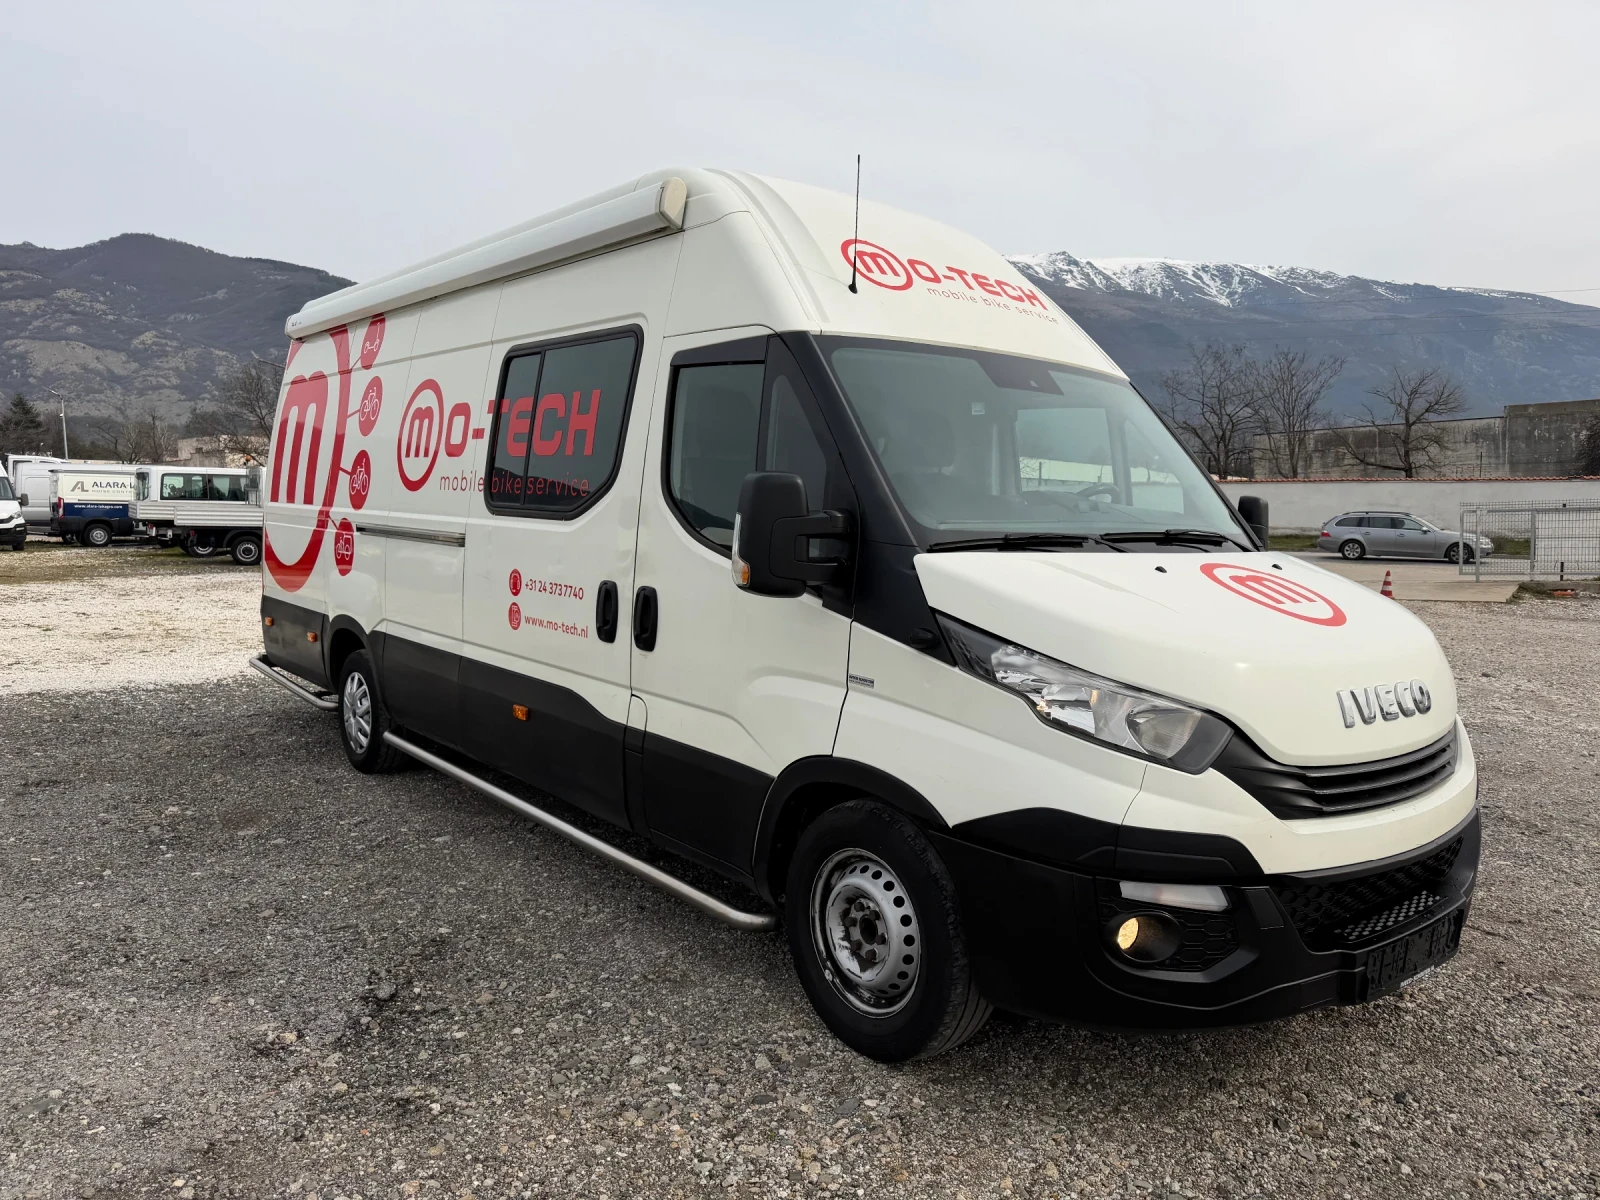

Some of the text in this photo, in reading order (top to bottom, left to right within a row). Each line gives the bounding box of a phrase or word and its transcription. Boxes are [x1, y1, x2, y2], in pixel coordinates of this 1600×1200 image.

[926, 287, 1059, 325] mobile bike service
[439, 469, 590, 497] mobile bike service
[525, 578, 537, 592] +31
[538, 580, 547, 594] 24
[524, 615, 588, 639] www.mo-tech.nl
[1335, 678, 1432, 729] IVECO
